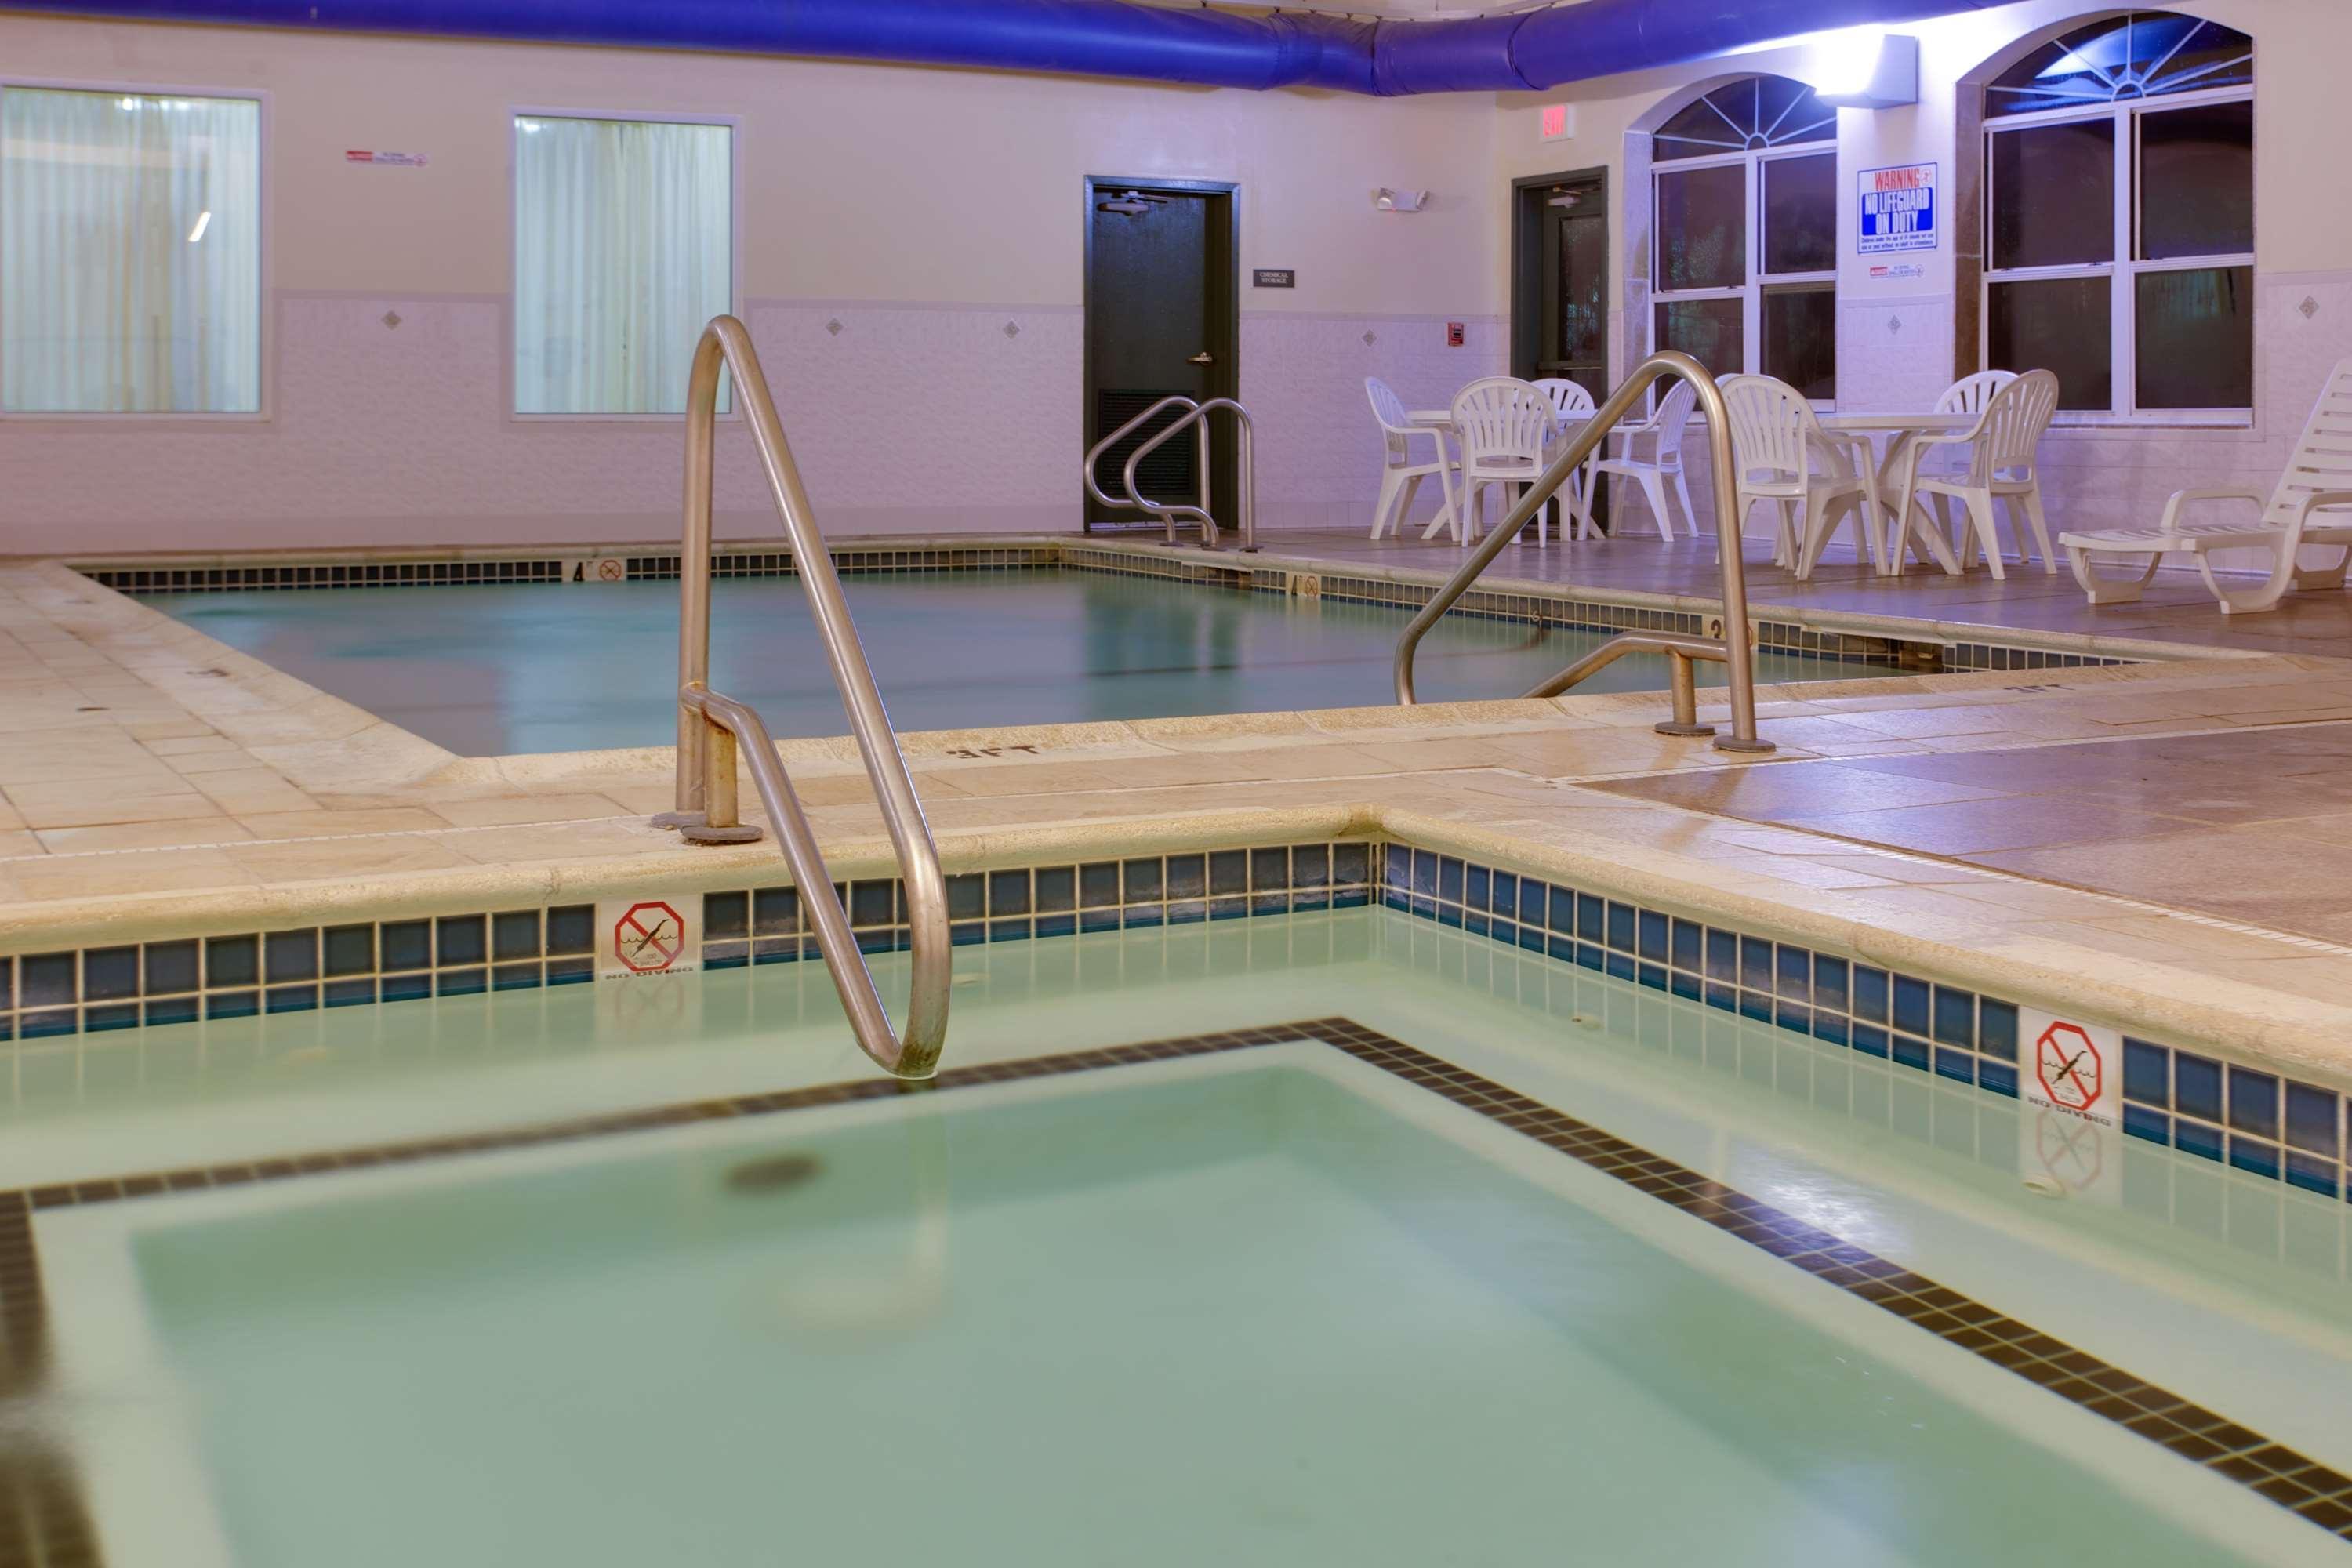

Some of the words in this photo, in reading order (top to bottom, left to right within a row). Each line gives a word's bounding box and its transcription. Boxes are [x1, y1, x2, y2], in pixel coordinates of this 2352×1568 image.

[1875, 168, 1920, 191] WARNING
[1864, 192, 1878, 216] NO
[1879, 187, 1930, 214] LIFEGUARD
[1875, 212, 1889, 235] ON
[1892, 210, 1919, 234] DUTY
[636, 967, 694, 978] DIVING
[2027, 1096, 2051, 1108] NO
[2056, 1105, 2112, 1127] DIVING
